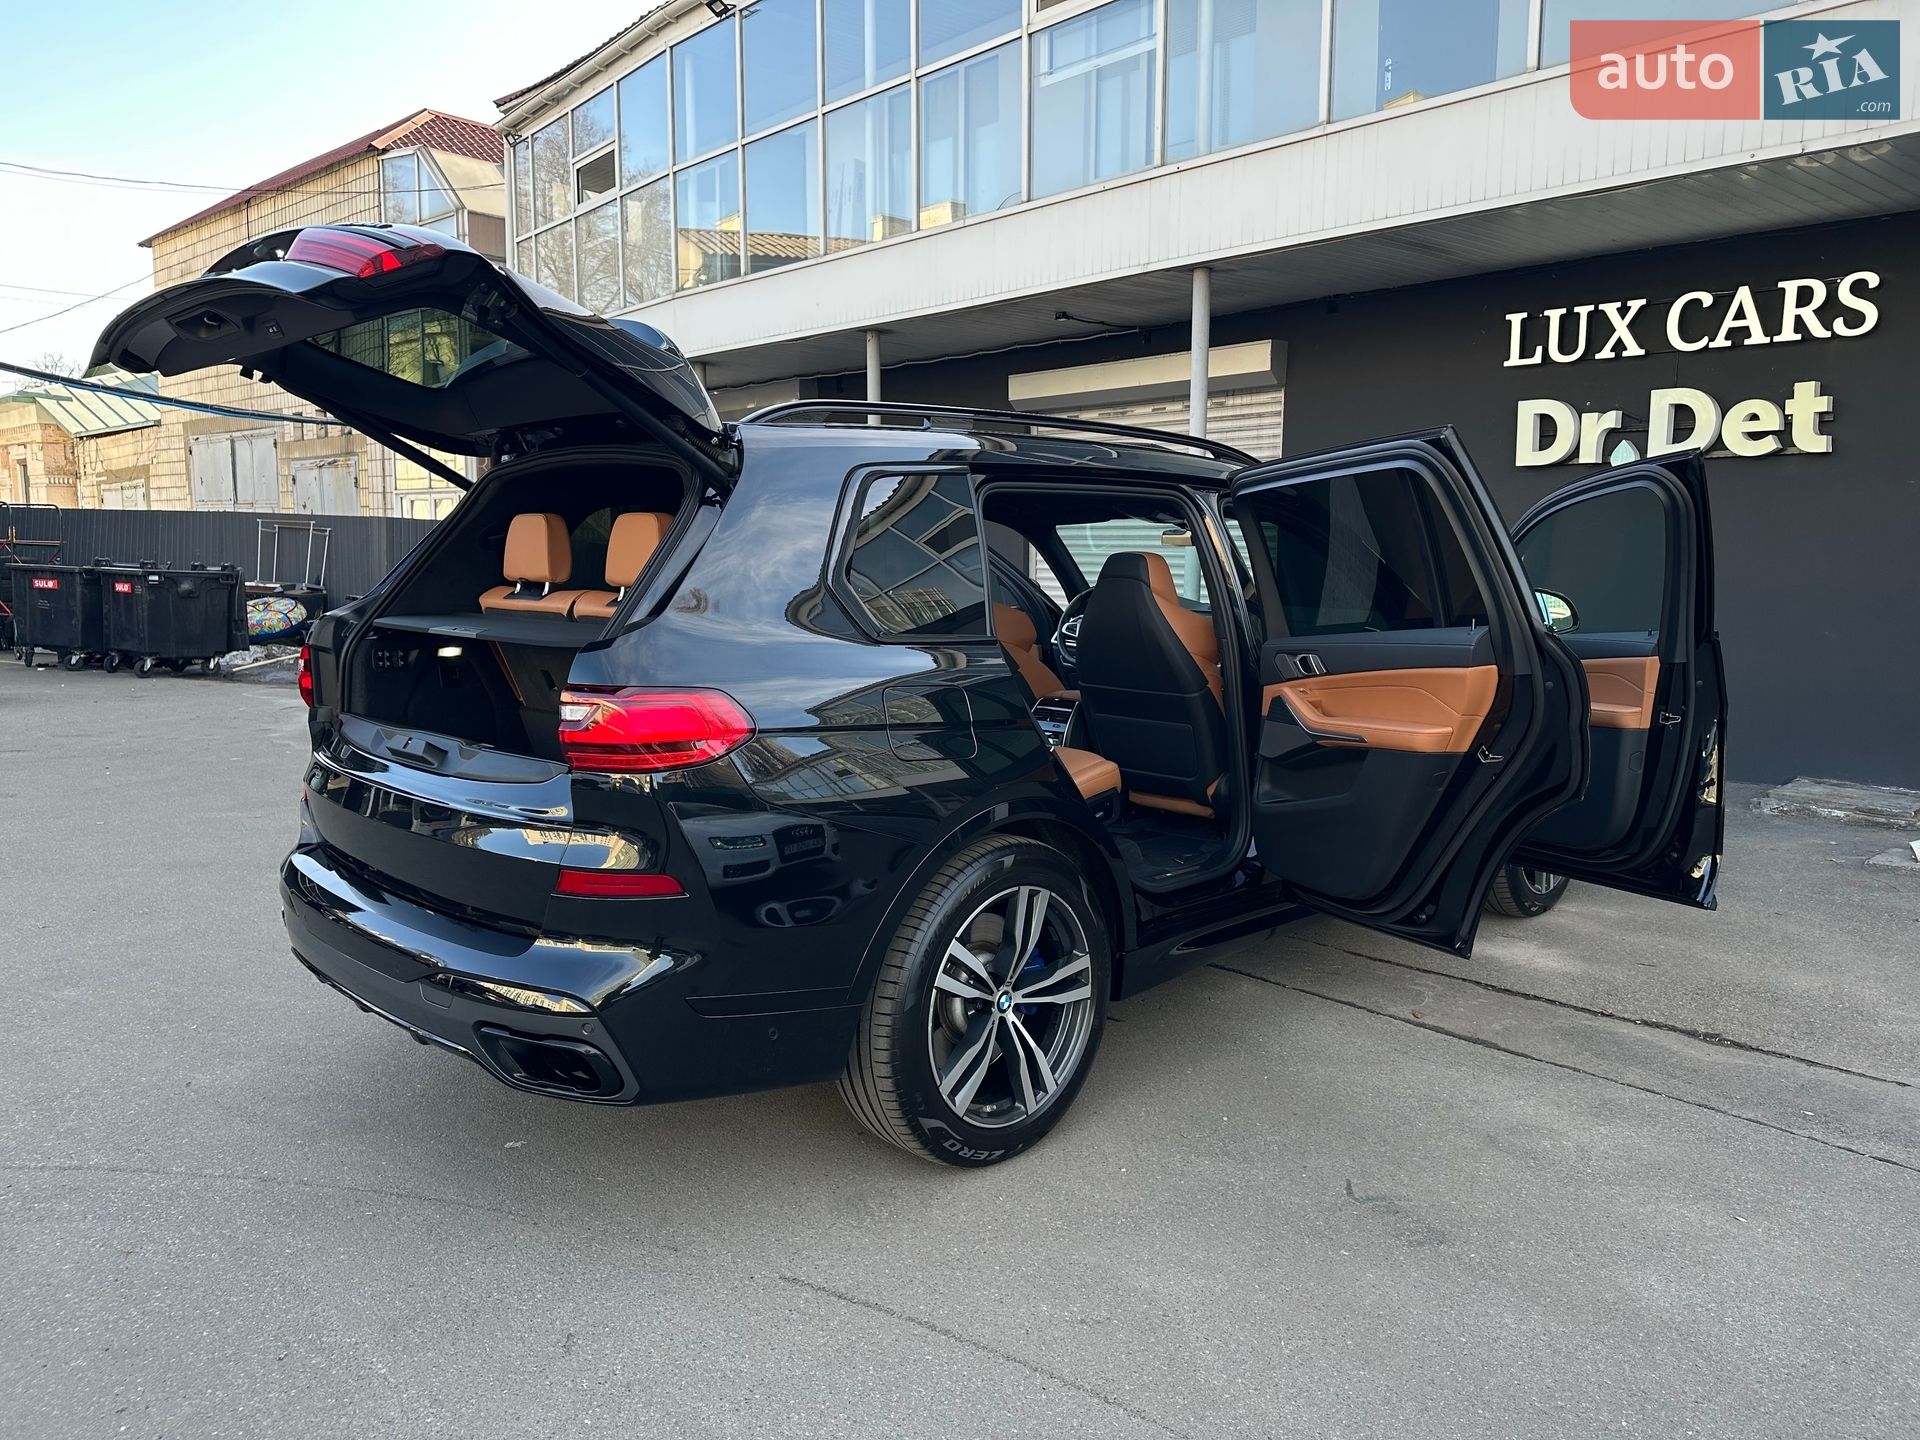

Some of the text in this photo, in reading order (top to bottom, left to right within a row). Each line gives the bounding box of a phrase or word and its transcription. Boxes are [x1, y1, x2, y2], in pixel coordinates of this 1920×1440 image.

[1503, 270, 1880, 368] LUX CARS
[942, 1139, 1005, 1160] ZERO
